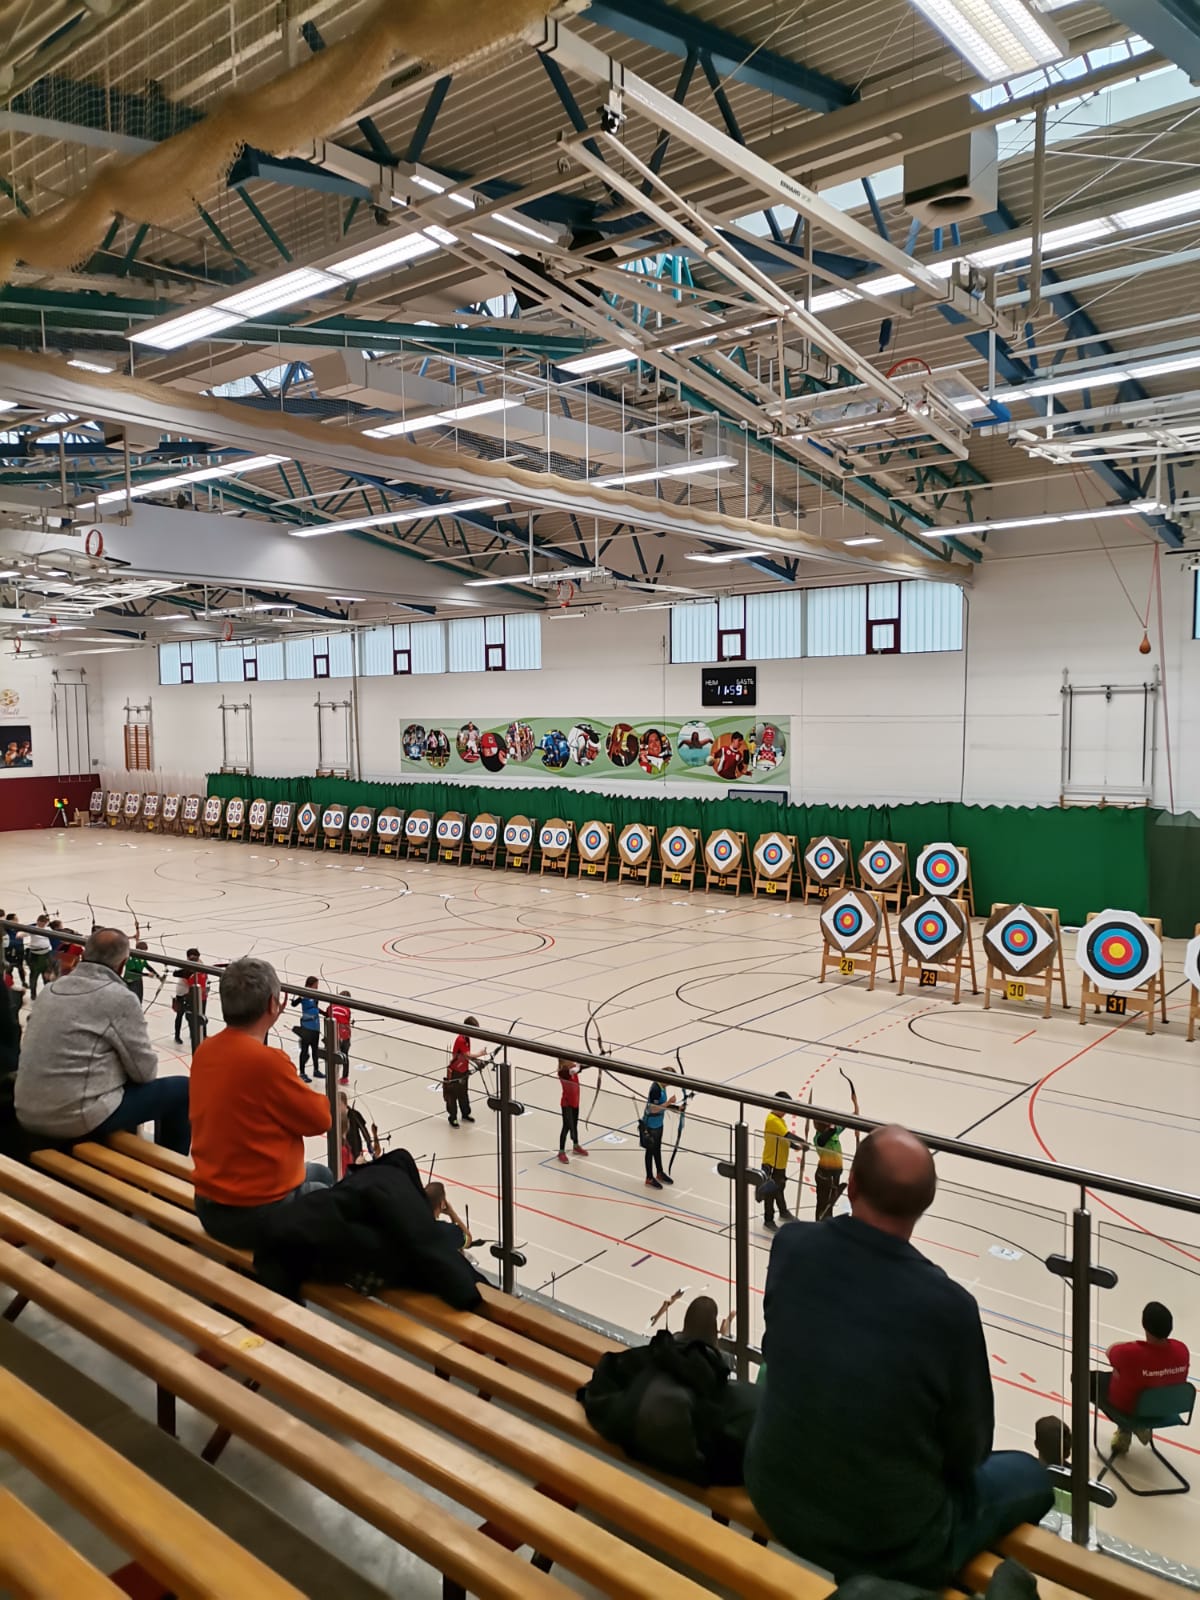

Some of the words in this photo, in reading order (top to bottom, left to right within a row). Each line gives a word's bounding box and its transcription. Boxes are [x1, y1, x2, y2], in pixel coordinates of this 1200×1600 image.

[841, 960, 853, 972] 28
[922, 971, 936, 985] 29
[1009, 984, 1024, 997] 30
[1108, 997, 1124, 1013] 31
